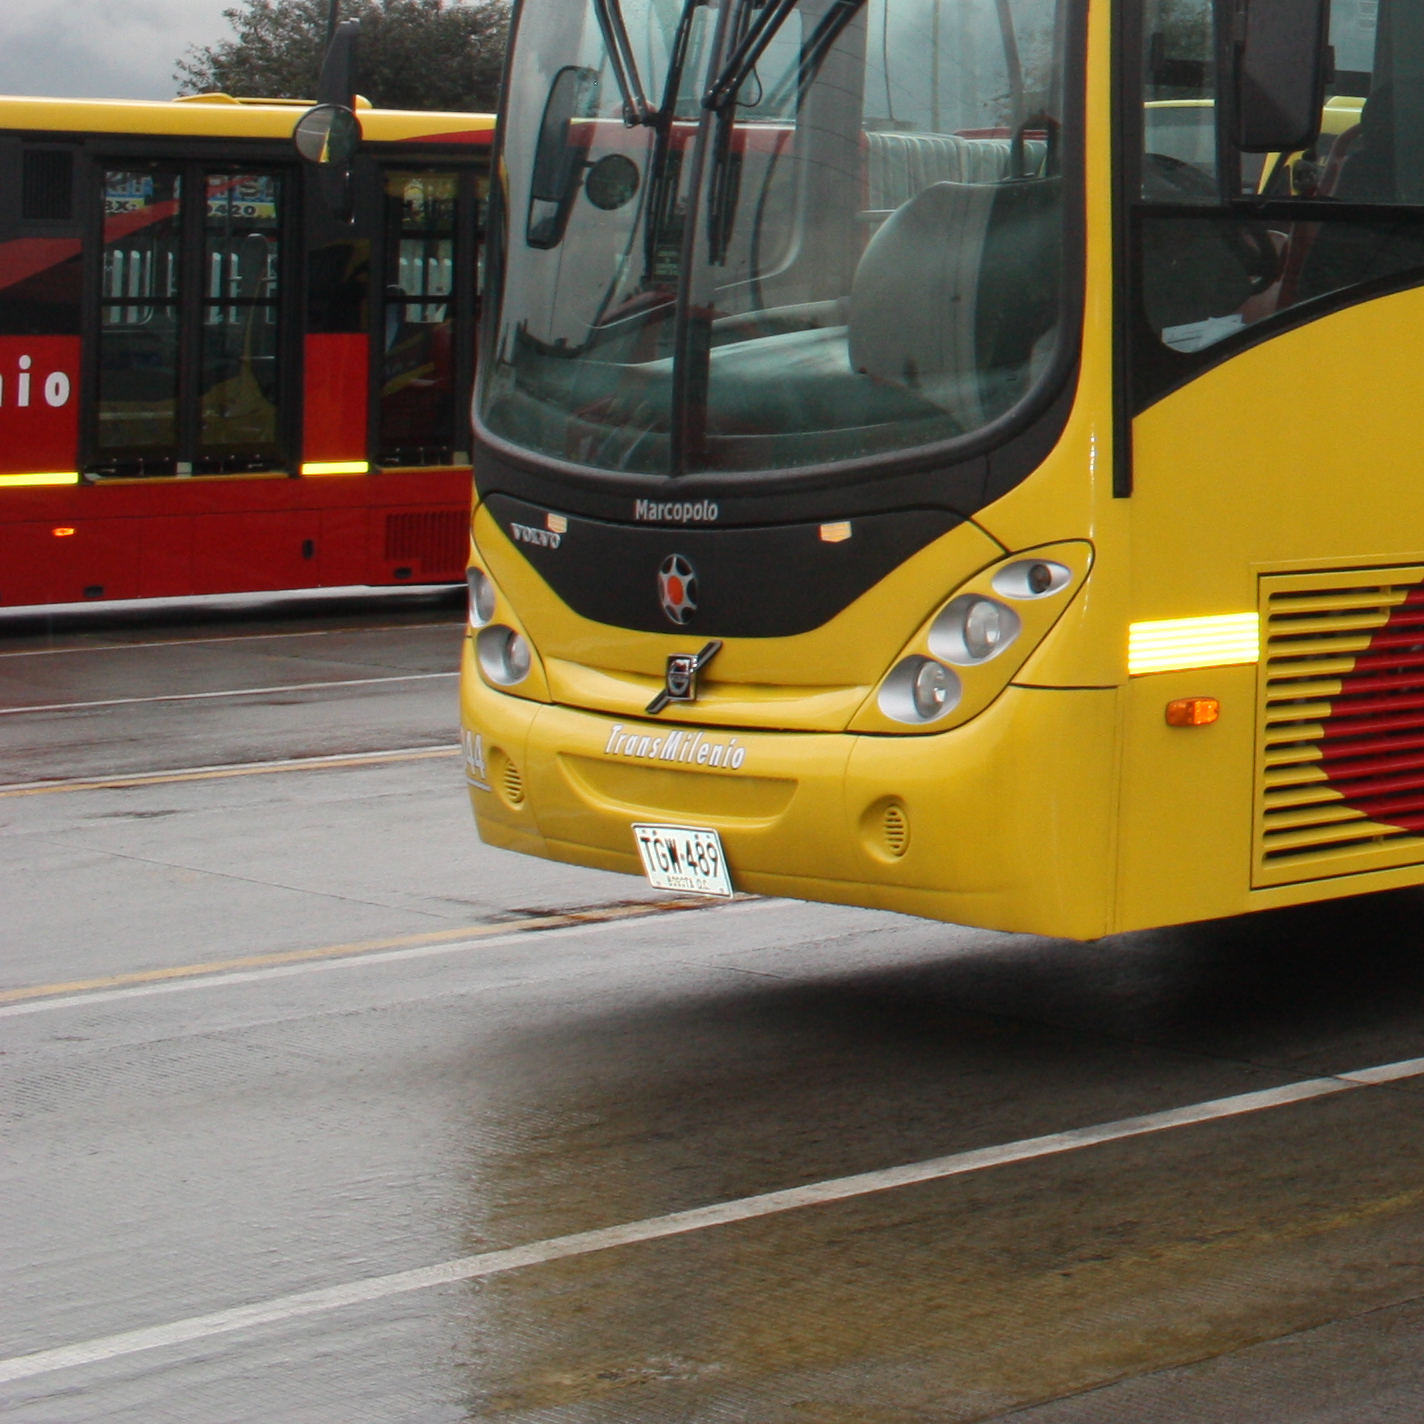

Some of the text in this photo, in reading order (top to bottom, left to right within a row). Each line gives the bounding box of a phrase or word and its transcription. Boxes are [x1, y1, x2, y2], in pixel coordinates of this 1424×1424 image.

[0, 353, 71, 408] io
[634, 498, 719, 523] Marcopolo
[510, 522, 561, 549] VOLVO
[461, 728, 486, 780] 44
[604, 724, 746, 770] TransMilenio
